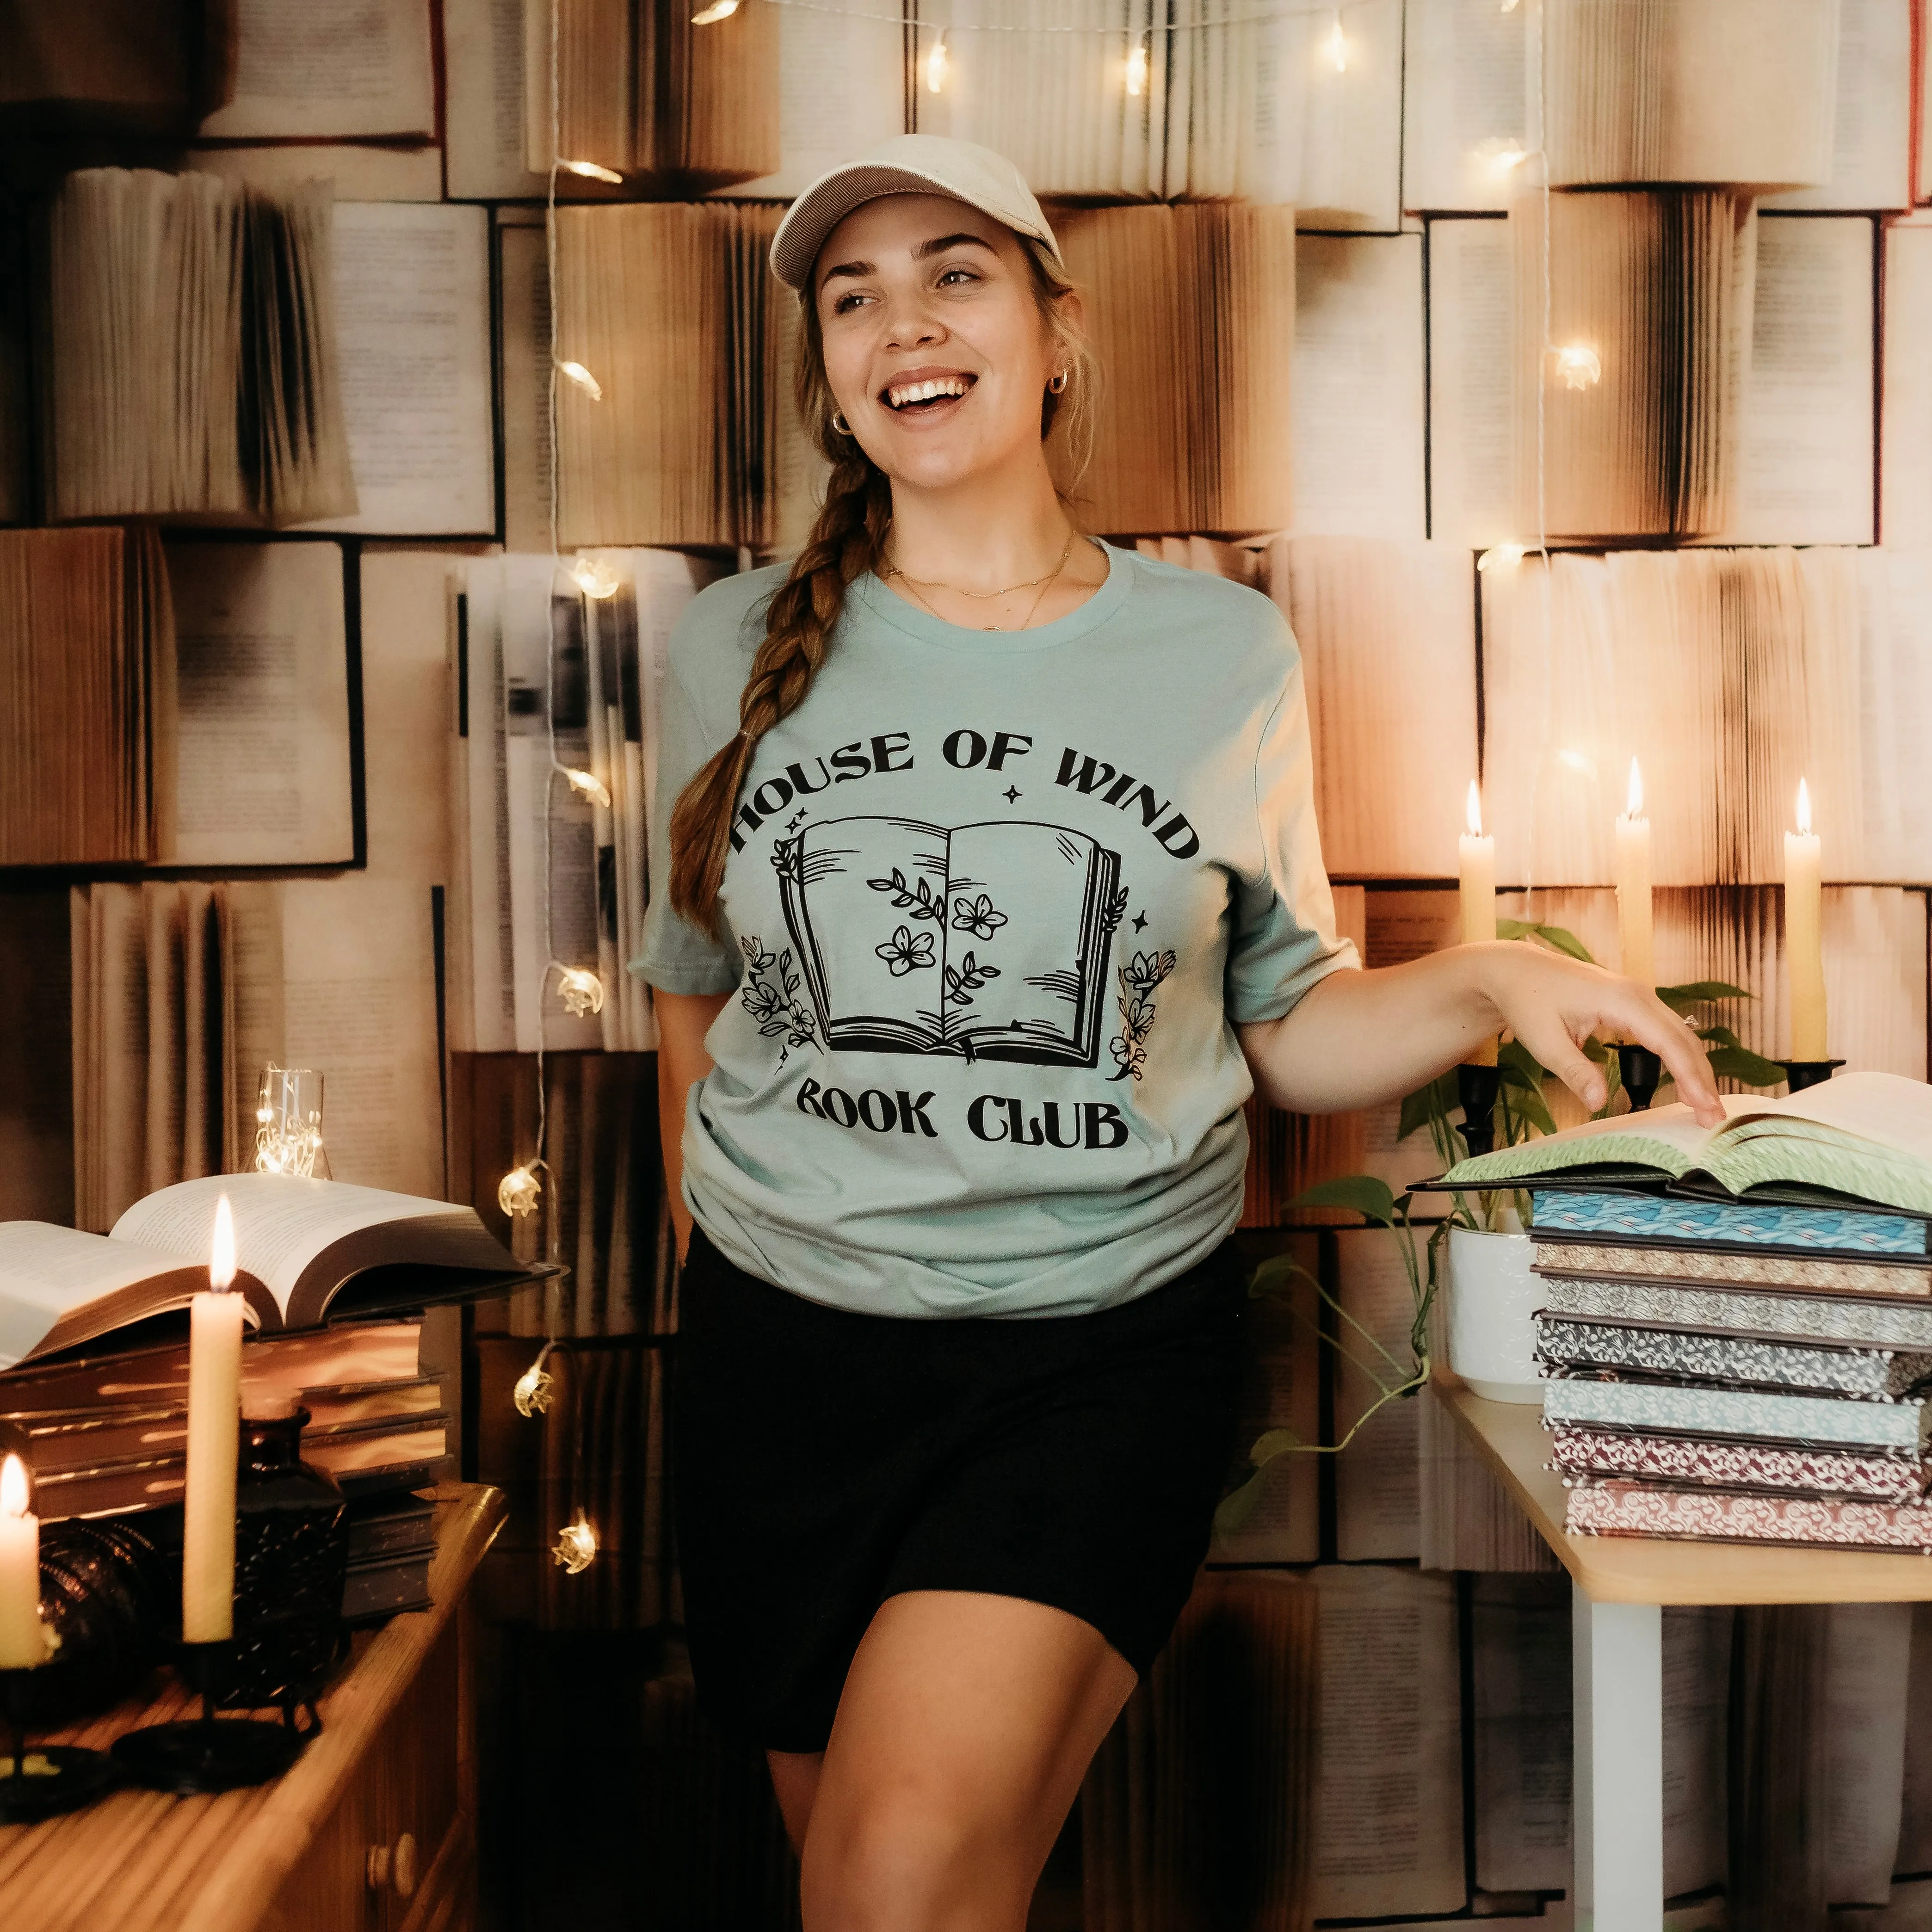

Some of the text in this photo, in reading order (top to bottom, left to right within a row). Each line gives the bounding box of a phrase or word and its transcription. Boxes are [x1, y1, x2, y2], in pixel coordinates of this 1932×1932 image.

[729, 729, 1200, 859] HOUSE OF WIND
[796, 1077, 1129, 1149] BOOK CLUB
